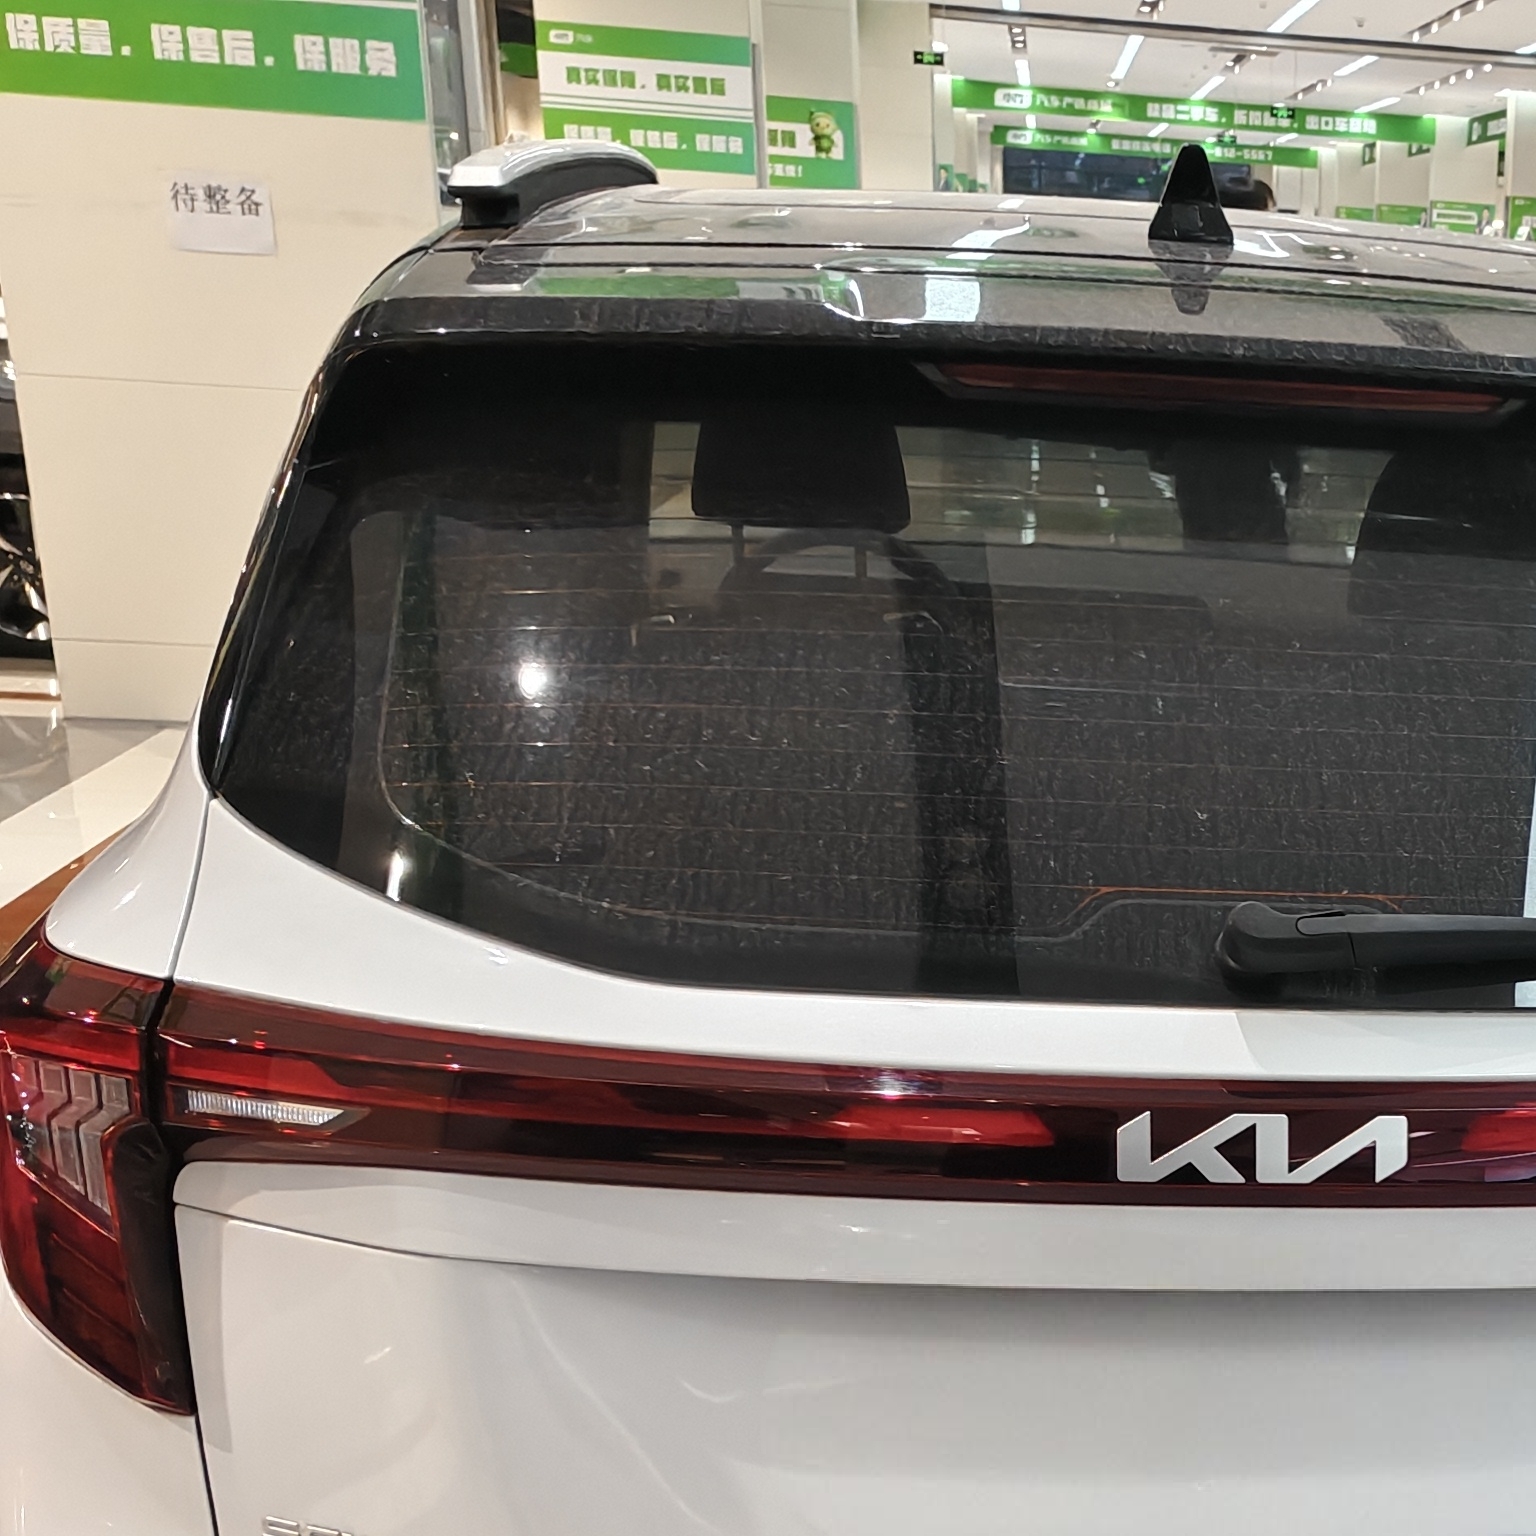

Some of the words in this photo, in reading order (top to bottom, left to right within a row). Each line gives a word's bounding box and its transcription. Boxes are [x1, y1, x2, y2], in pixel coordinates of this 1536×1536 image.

[170, 181, 264, 217] 待整备
[1117, 1110, 1408, 1184] KIA
